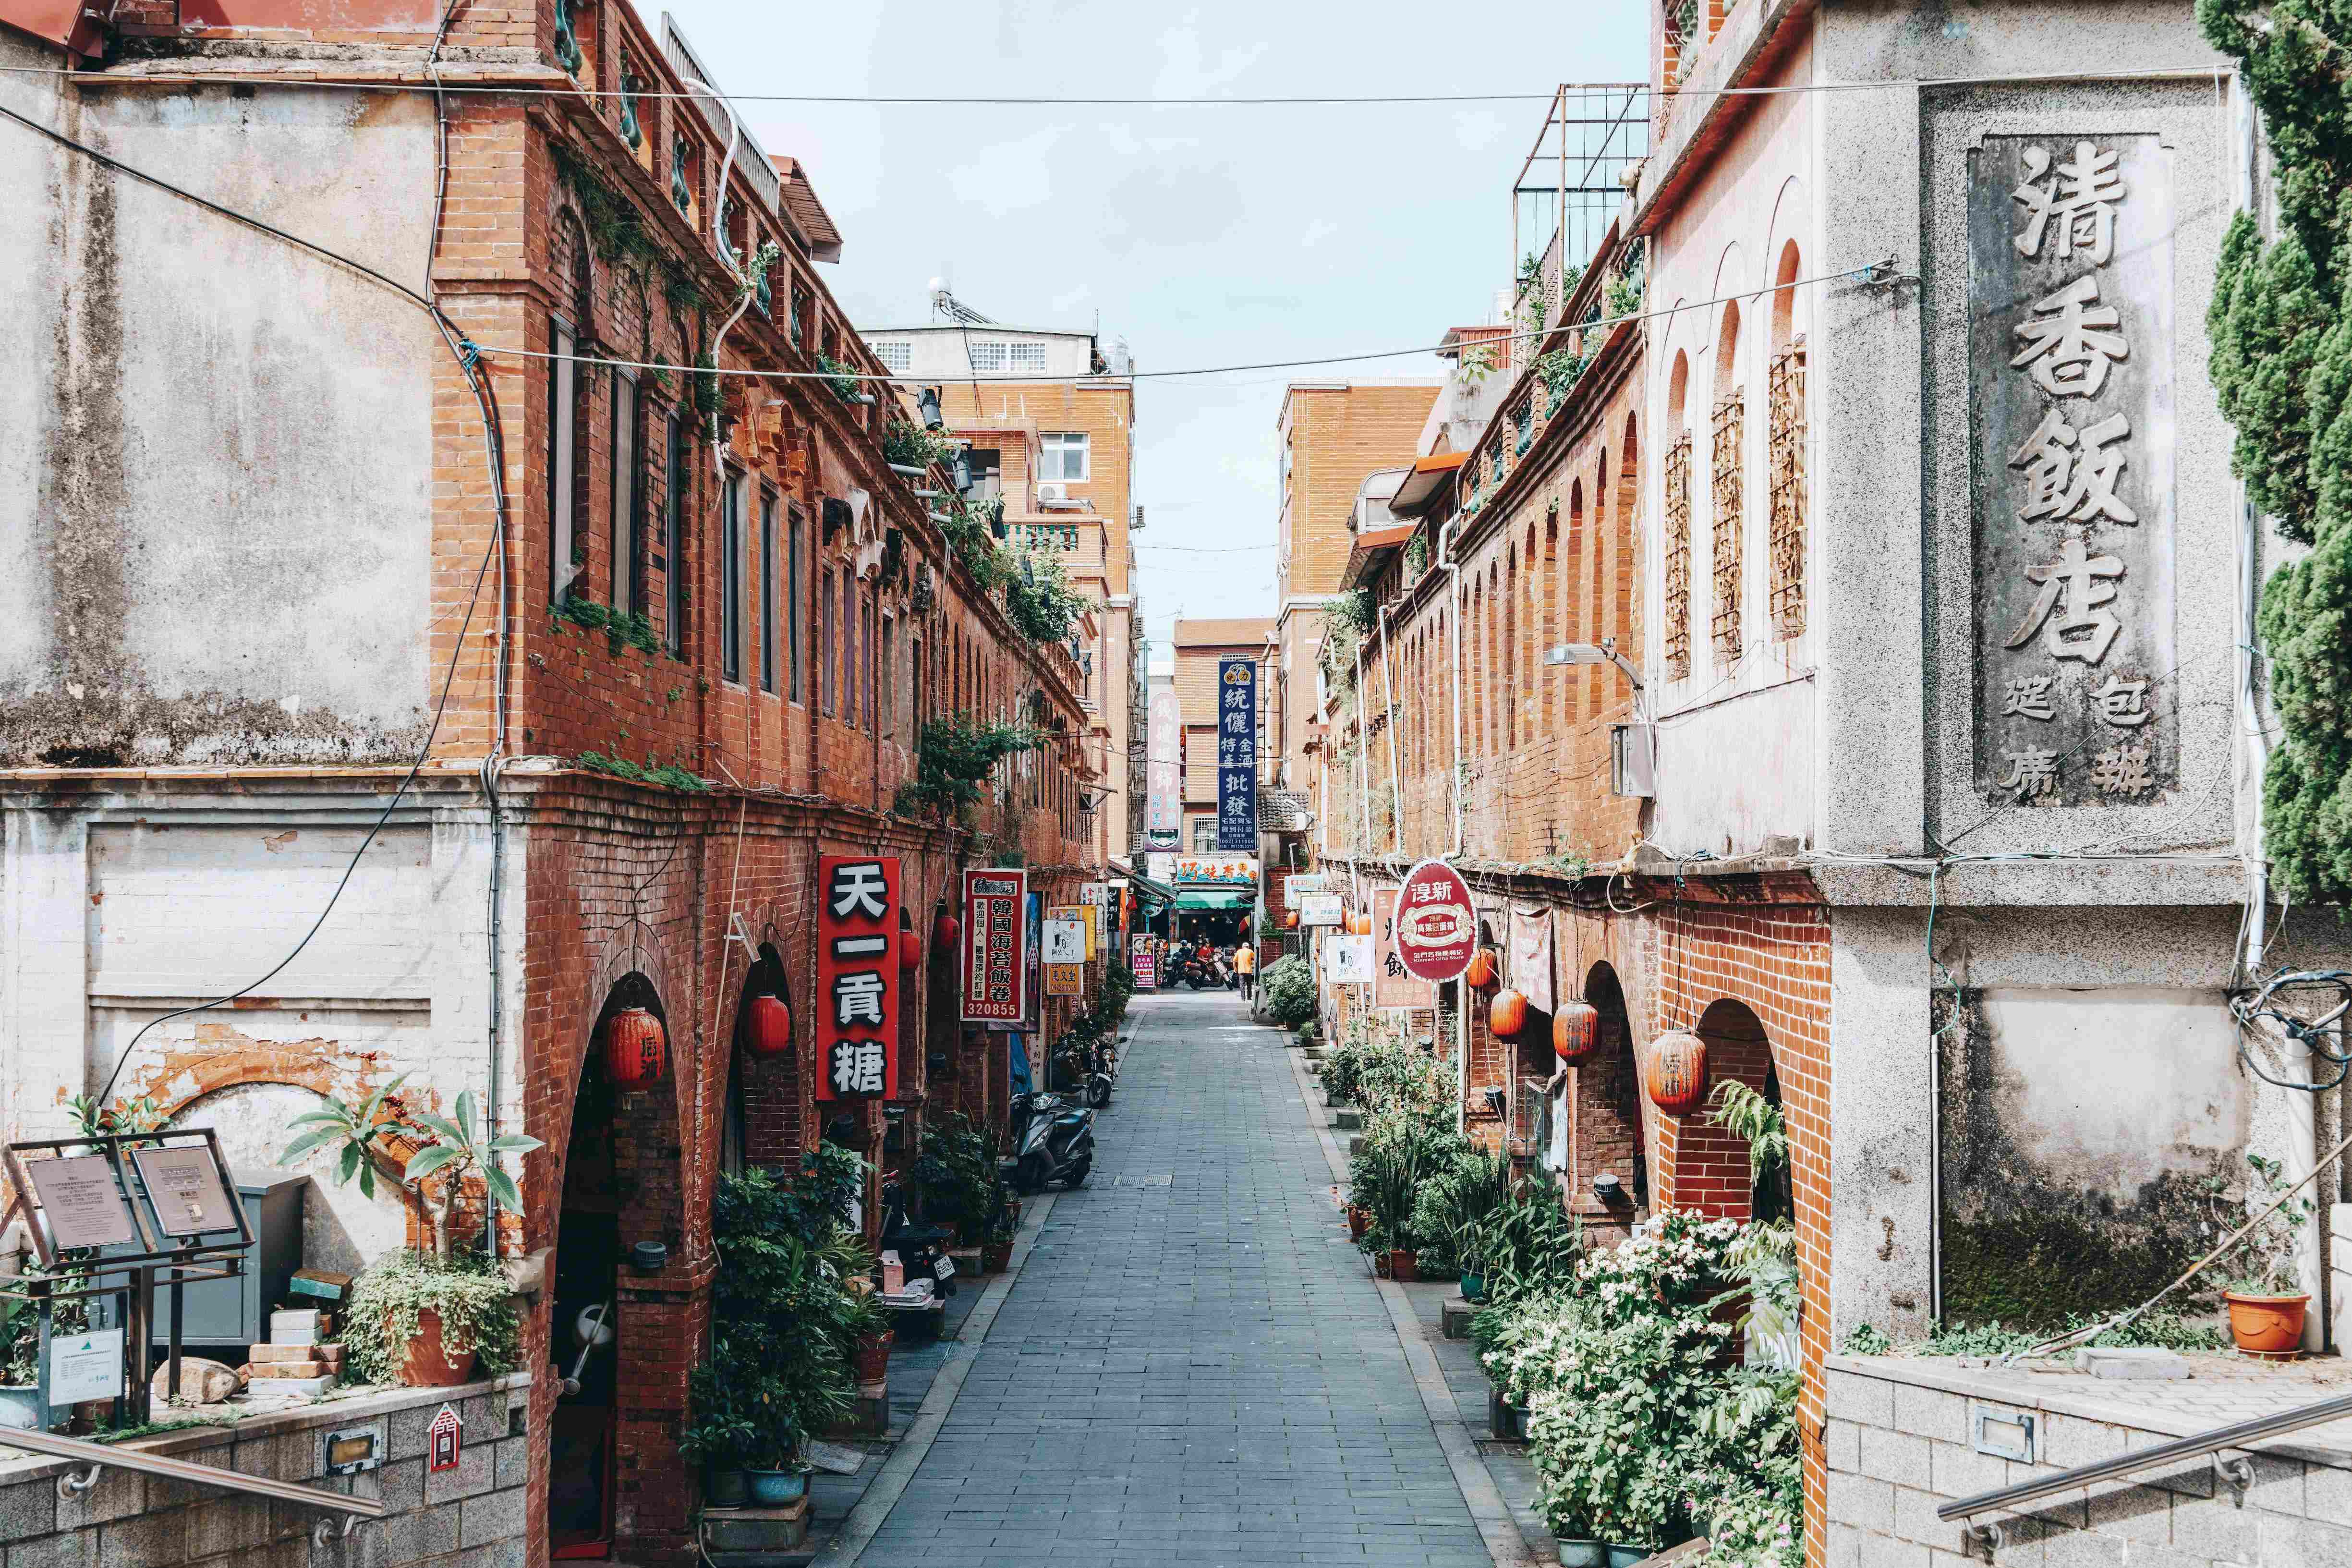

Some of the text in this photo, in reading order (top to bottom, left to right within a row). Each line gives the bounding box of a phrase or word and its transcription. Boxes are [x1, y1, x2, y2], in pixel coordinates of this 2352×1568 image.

[2006, 141, 2137, 664] 清香飯店
[1225, 774, 1249, 816] 批發
[832, 863, 888, 1094] 天一貢糖
[989, 899, 1014, 1002] 韓國海苔飯卷
[968, 1003, 1016, 1015] 320855
